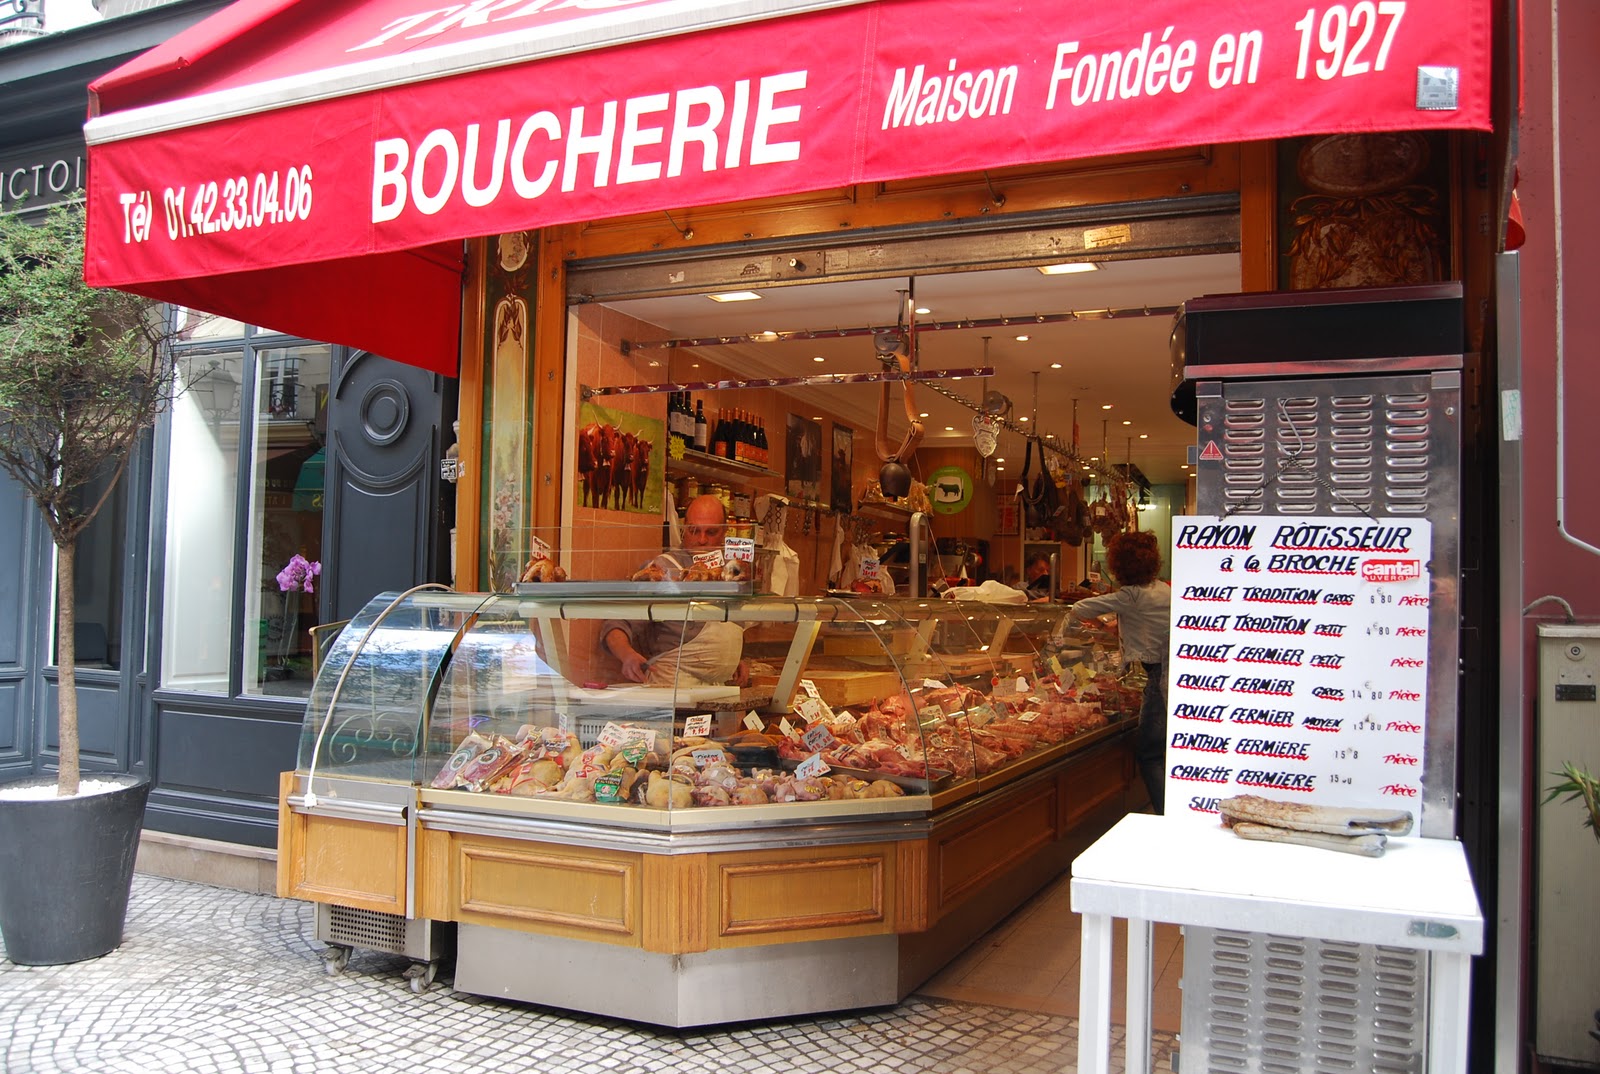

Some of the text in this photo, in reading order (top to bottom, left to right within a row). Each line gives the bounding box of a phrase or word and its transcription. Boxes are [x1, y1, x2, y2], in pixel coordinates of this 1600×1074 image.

[881, 0, 1407, 131] Maison Fondée en 1927
[371, 69, 808, 224] BOUCHERIE
[120, 164, 313, 244] Tél 01.42.33.04.06
[1177, 524, 1257, 547] RAYON
[1267, 554, 1360, 572] BROCHE
[1362, 560, 1419, 576] cantal
[1183, 585, 1238, 600] POULET
[1176, 614, 1231, 632] POULET
[1177, 643, 1236, 661] POULET
[1177, 673, 1231, 692] POULET
[1311, 686, 1345, 698] GROS
[1174, 703, 1230, 720] POULET
[1301, 716, 1344, 728] MOYEN
